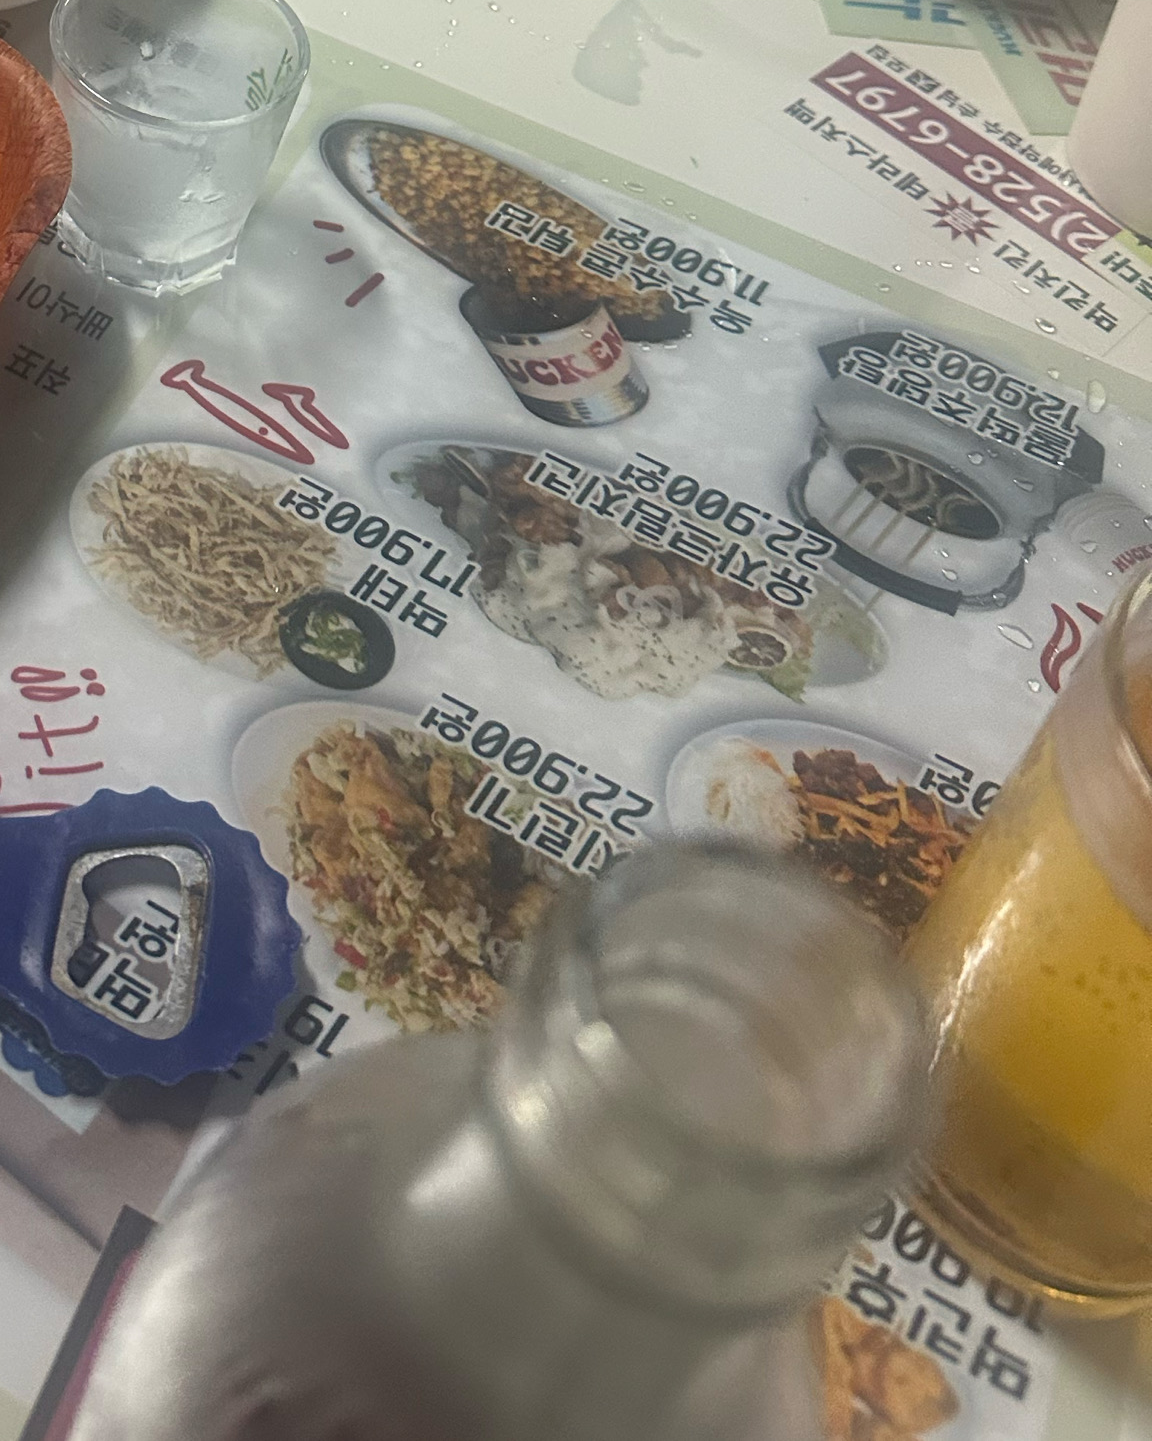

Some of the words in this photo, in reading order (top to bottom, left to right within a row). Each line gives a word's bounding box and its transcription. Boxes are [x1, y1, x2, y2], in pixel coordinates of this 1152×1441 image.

[783, 97, 930, 202] 테라스치맥
[824, 68, 1111, 256] 2)528-6797
[993, 239, 1120, 334] 먹킨치킨
[492, 320, 624, 387] UCKEN
[892, 330, 1081, 435] 12.900원
[278, 476, 477, 599] 17.900원
[528, 451, 814, 607] 유자크림치킨
[618, 451, 835, 572] 22.900원
[349, 563, 448, 639] 먹태
[420, 691, 655, 837] 22.900원
